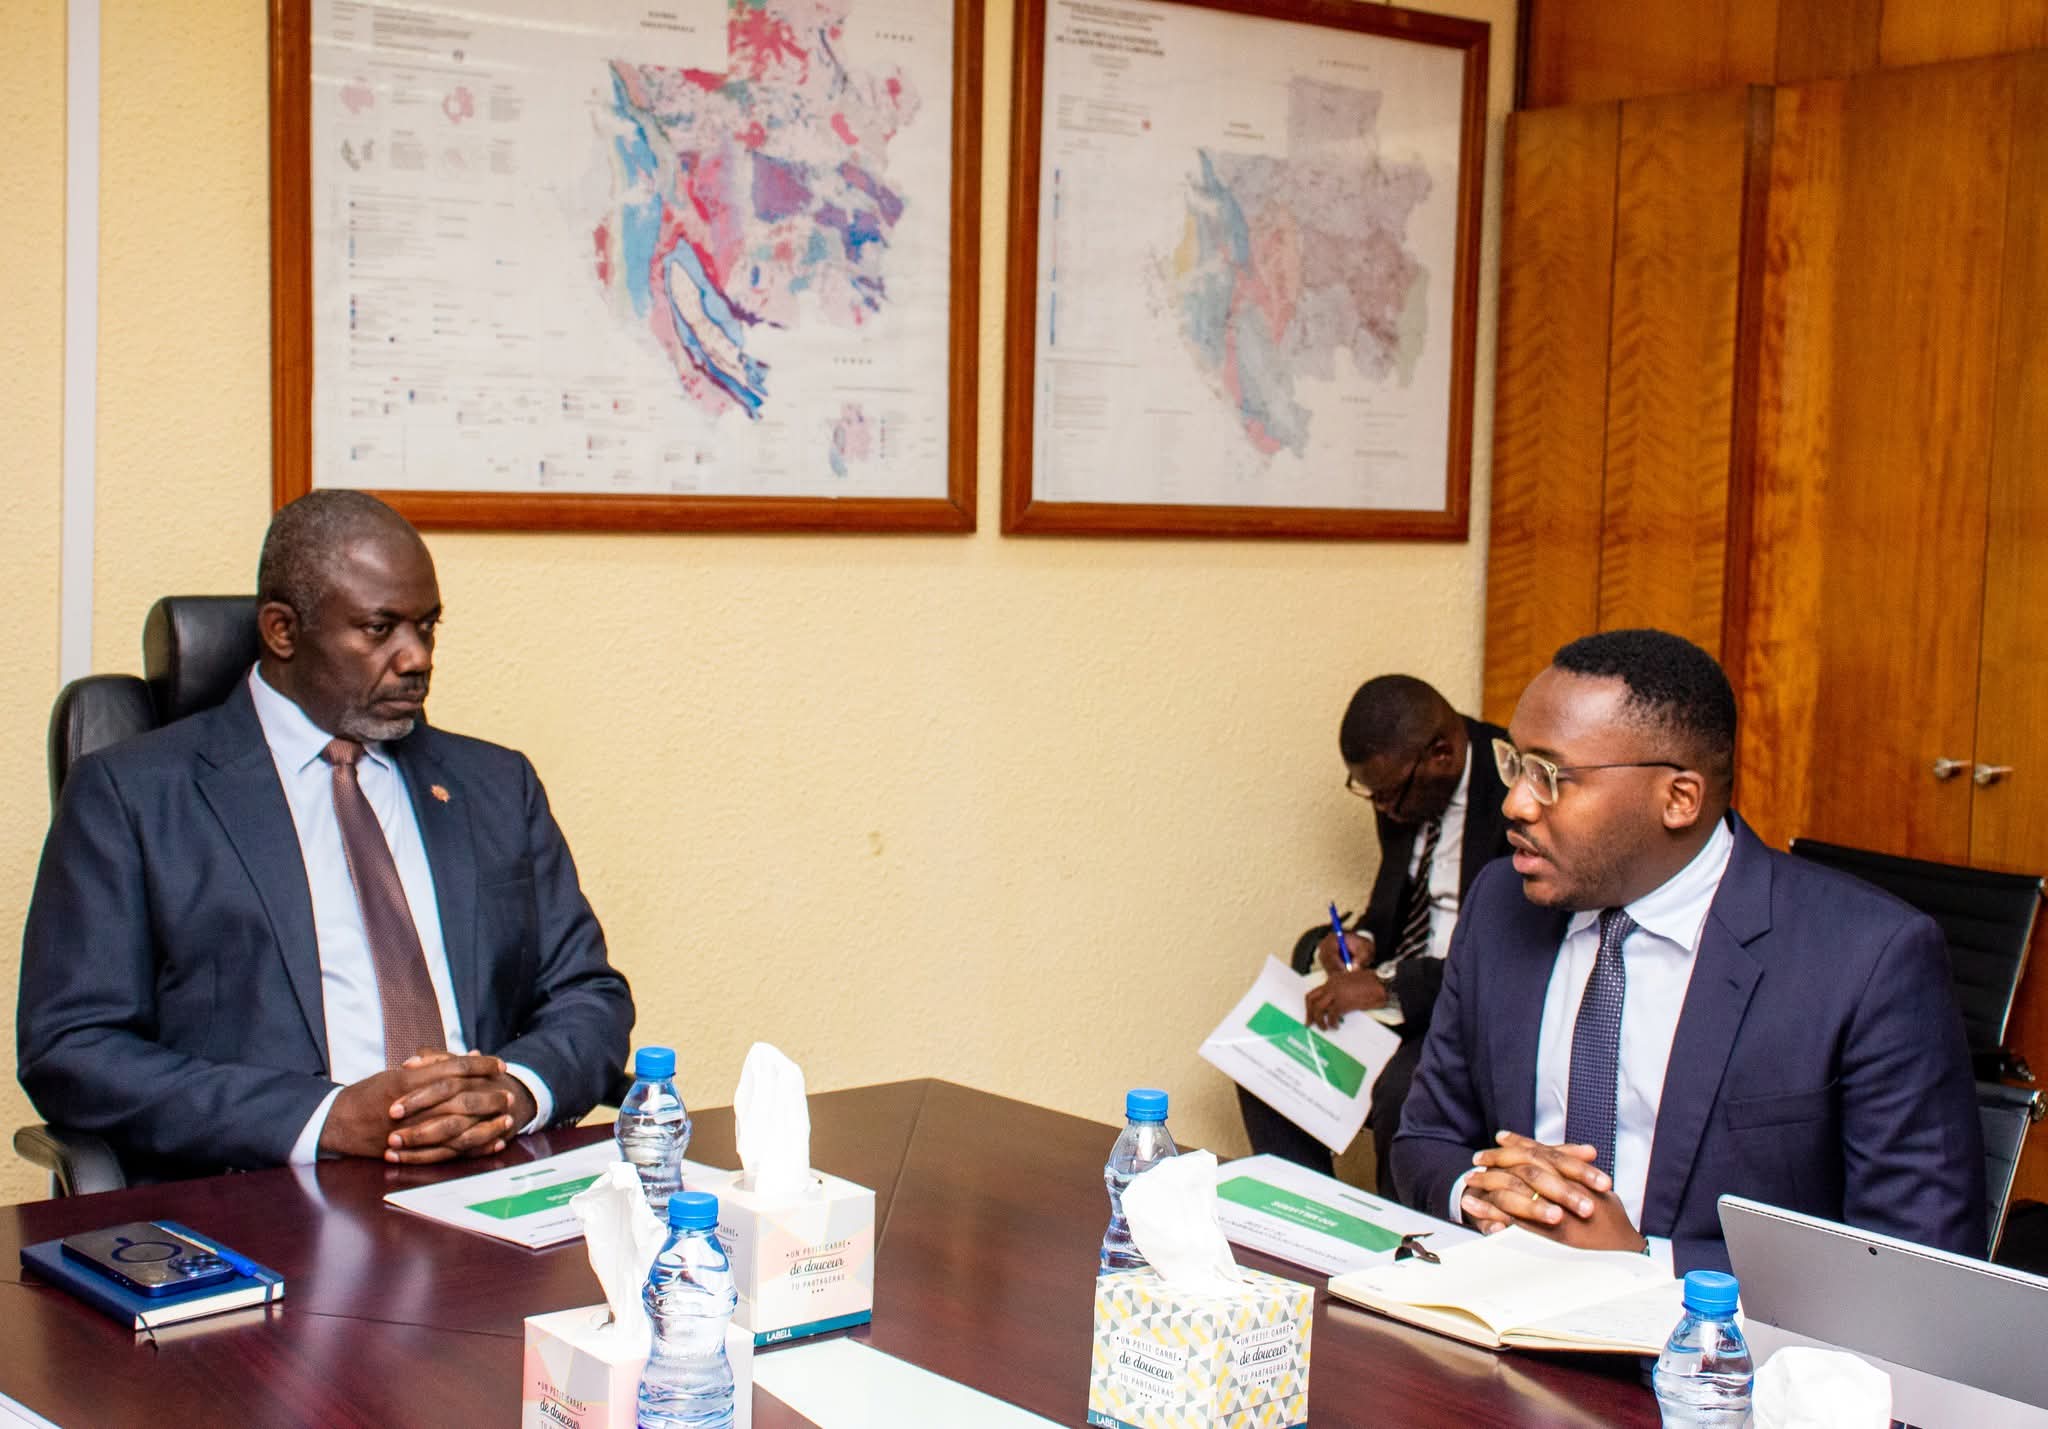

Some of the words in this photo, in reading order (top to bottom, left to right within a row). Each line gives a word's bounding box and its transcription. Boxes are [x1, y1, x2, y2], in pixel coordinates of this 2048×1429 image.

[791, 1250, 800, 1258] UN
[803, 1244, 821, 1256] PETIT
[790, 1263, 801, 1276] de
[804, 1258, 844, 1273] douceur
[766, 1328, 792, 1342] LABELL
[1240, 1337, 1249, 1345] UN
[1252, 1331, 1268, 1342] PETIT
[1120, 1336, 1130, 1345] UN
[1133, 1340, 1152, 1352] PETIT
[1240, 1350, 1251, 1366] de
[1253, 1346, 1288, 1361] douceur
[1119, 1350, 1131, 1365] de
[1133, 1355, 1174, 1380] douceur
[1251, 1362, 1288, 1378] PARTAGERAS
[1120, 1372, 1129, 1383] TU
[1132, 1377, 1174, 1399] PARTAGERAS
[540, 1397, 549, 1413] de
[550, 1403, 580, 1429] douceur
